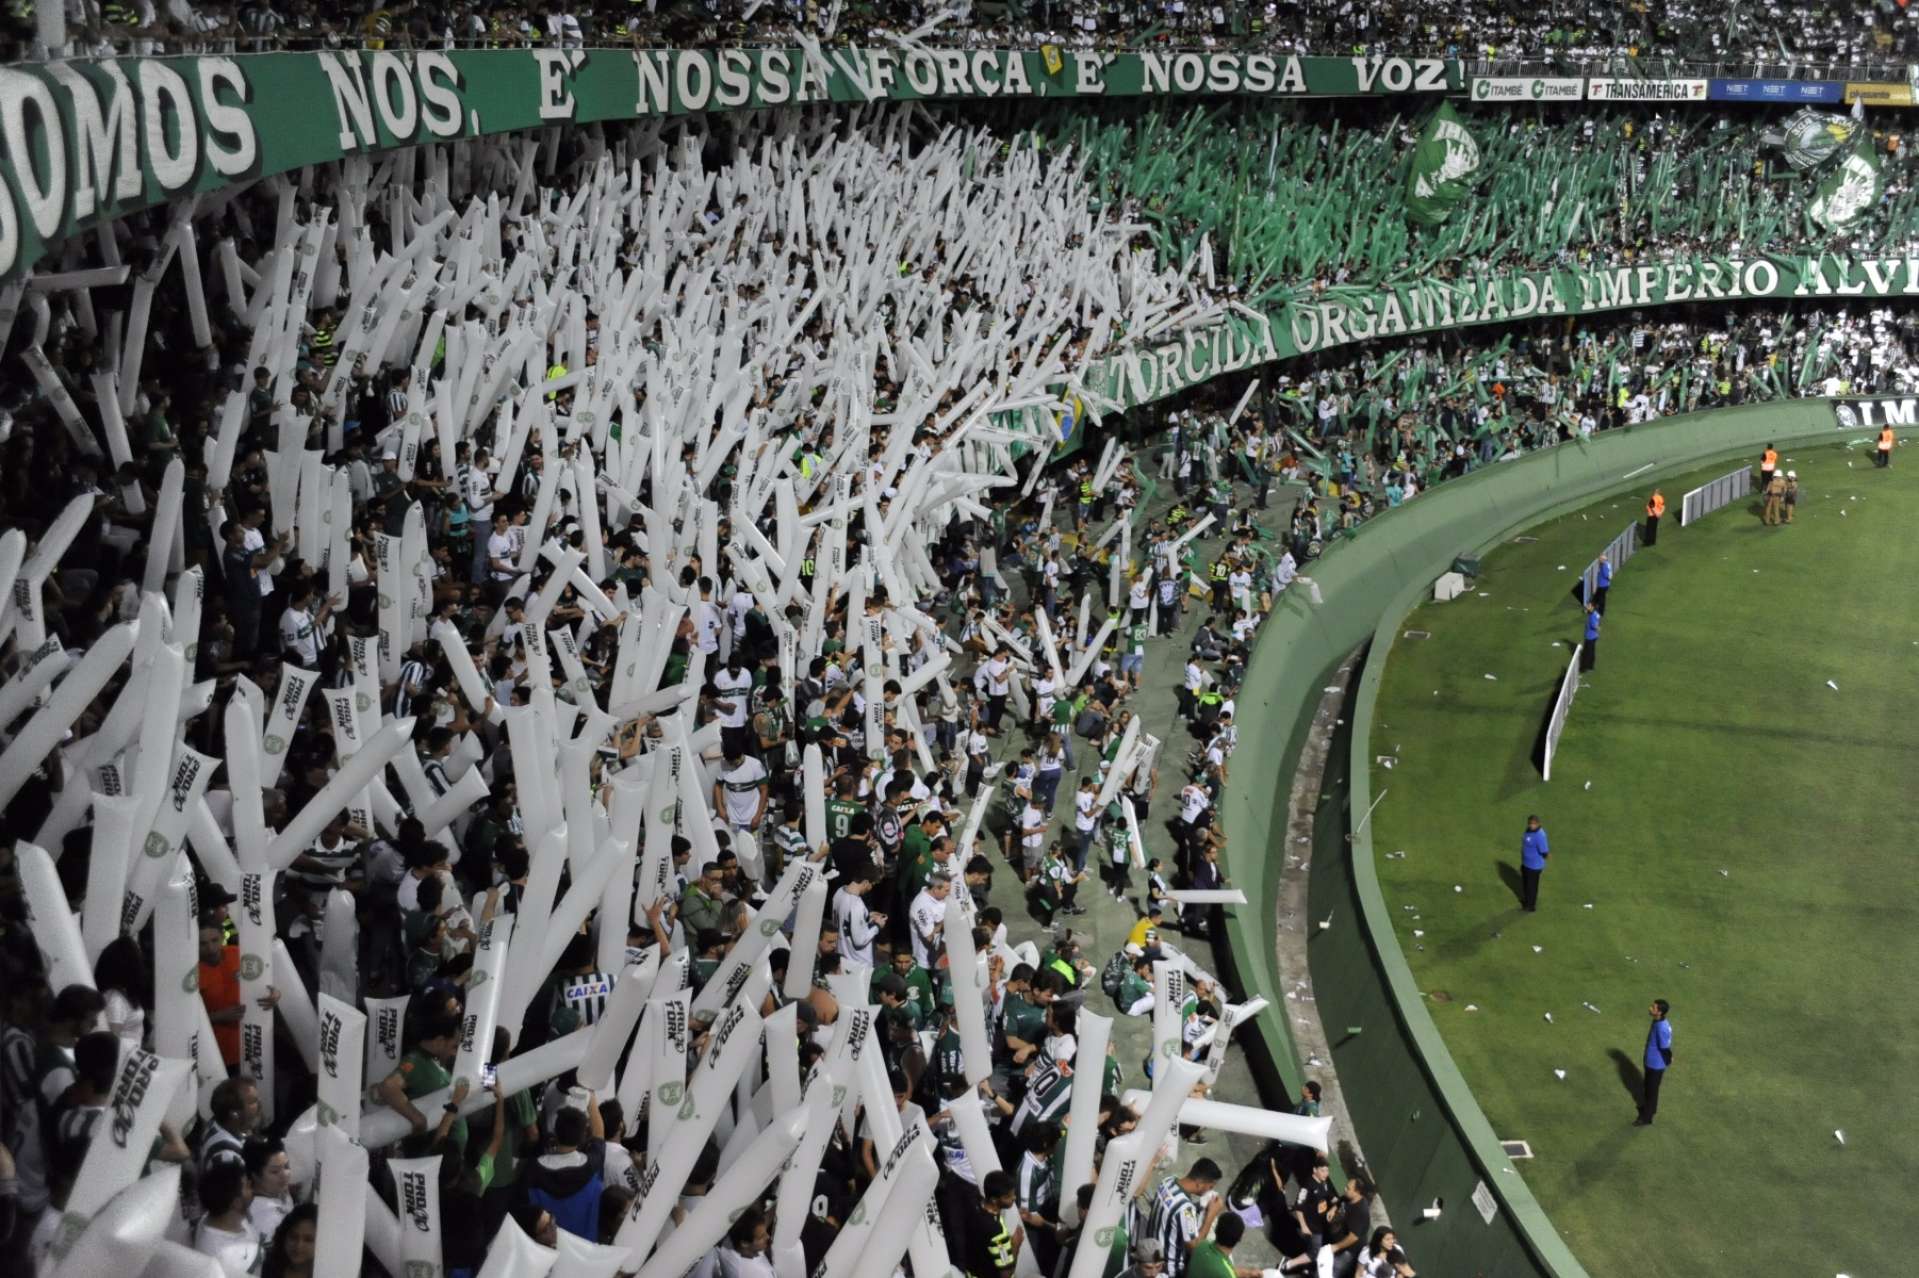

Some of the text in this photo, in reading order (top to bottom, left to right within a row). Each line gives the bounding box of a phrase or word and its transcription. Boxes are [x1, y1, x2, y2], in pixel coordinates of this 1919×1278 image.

[1605, 83, 1688, 99] TRANSAMERICA
[0, 57, 256, 276] OMOS
[633, 49, 829, 114] NOSSA
[1141, 52, 1307, 92] NOSSA
[172, 753, 195, 790] TORK
[181, 759, 200, 792] PRO
[836, 815, 848, 838] 9
[567, 982, 608, 998] CAIXA
[320, 1011, 335, 1054] TORK
[379, 1008, 388, 1045] TORK
[388, 1008, 398, 1039] PRO
[665, 1000, 677, 1040] TORK
[674, 999, 685, 1036] PRO
[848, 1009, 861, 1045] TORK
[857, 1010, 870, 1043] PRO
[244, 1024, 252, 1062] TORK
[252, 1024, 262, 1062] PRO
[327, 1017, 343, 1056] PRO
[111, 1048, 148, 1110] TORK
[127, 1054, 160, 1108] PRO
[404, 1171, 415, 1215] TORK
[414, 1172, 427, 1210] PRO
